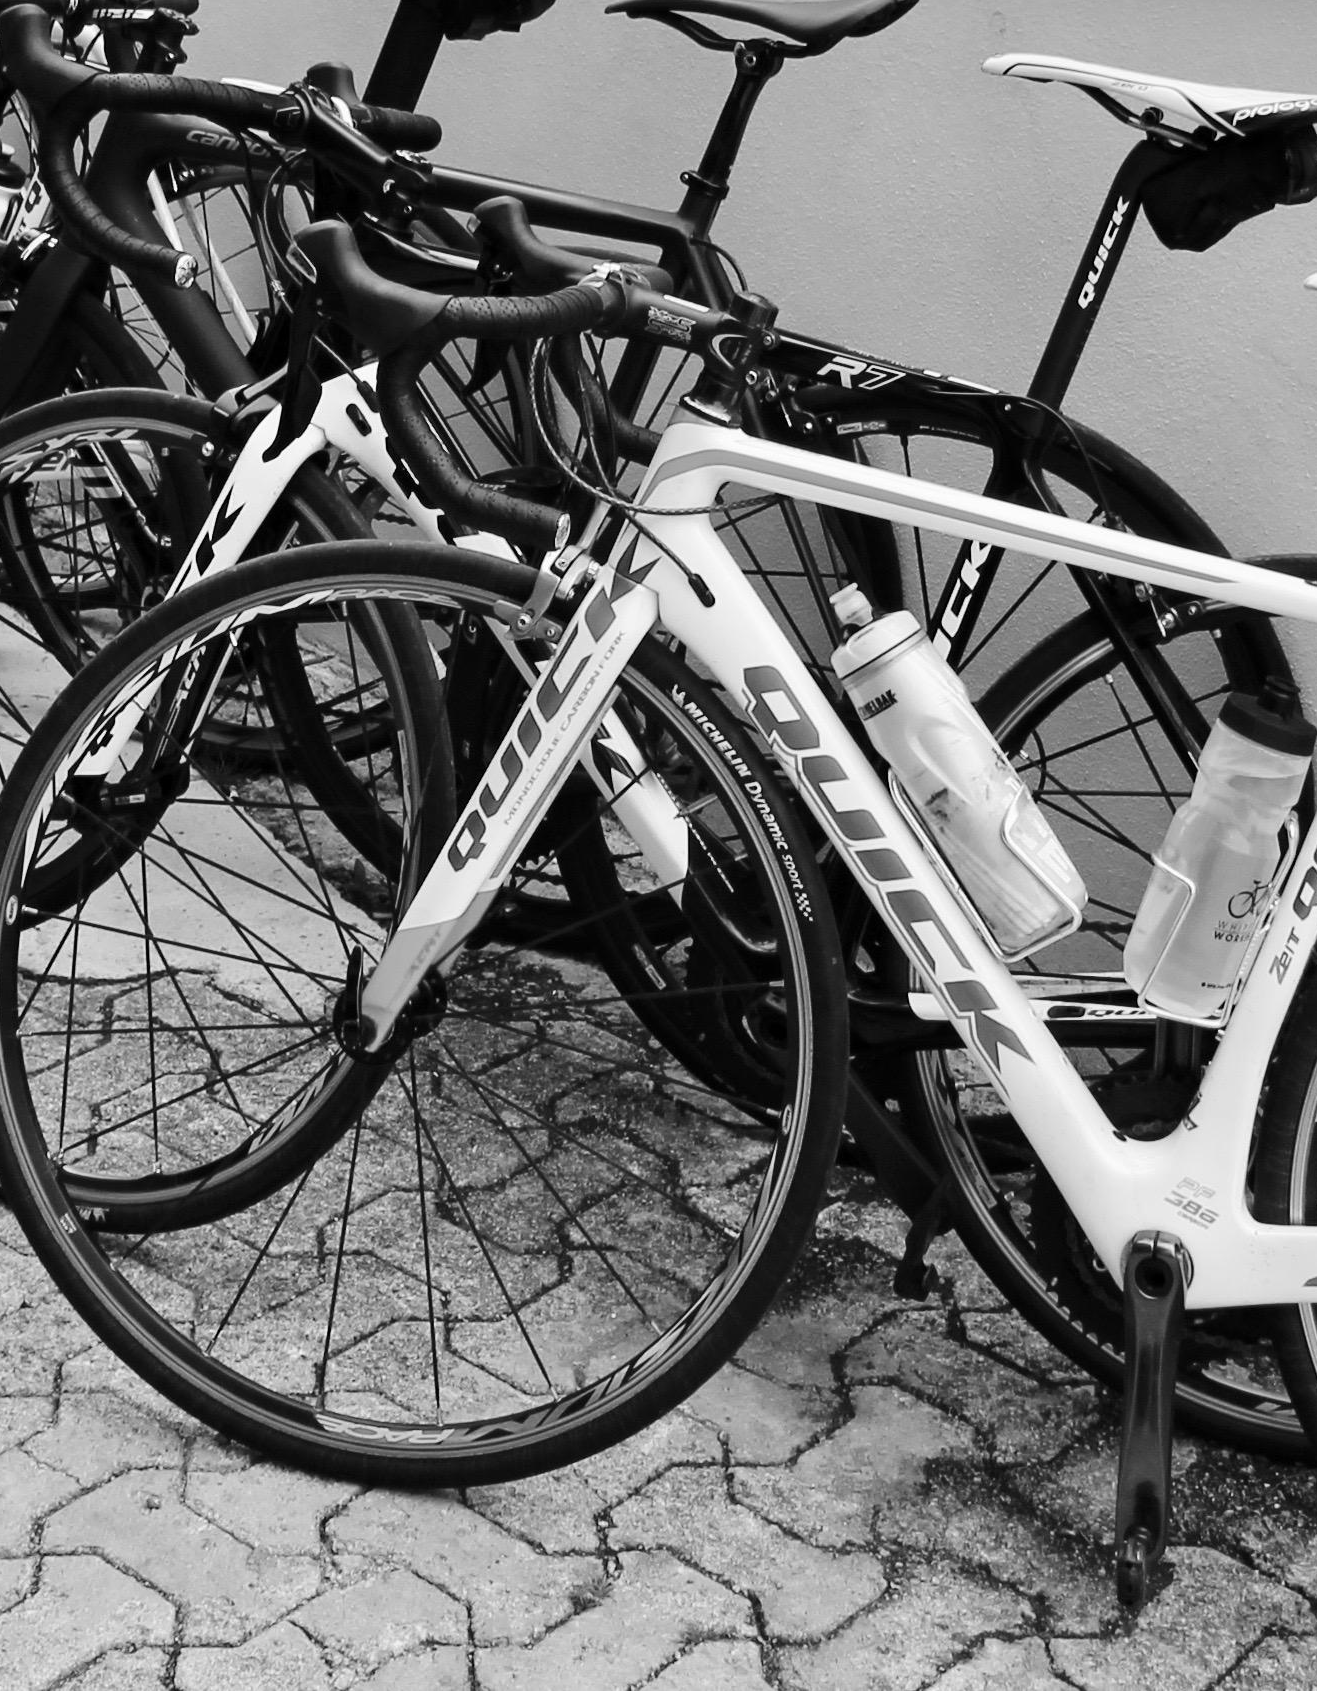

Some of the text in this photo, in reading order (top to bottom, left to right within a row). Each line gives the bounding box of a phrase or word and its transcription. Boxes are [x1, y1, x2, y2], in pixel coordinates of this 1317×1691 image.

[1078, 195, 1130, 309] QUICK
[817, 356, 907, 391] R7
[448, 532, 662, 872] QUICK
[685, 701, 804, 891] MICHELIN Dynamic sport
[743, 665, 1036, 1077] QUICK
